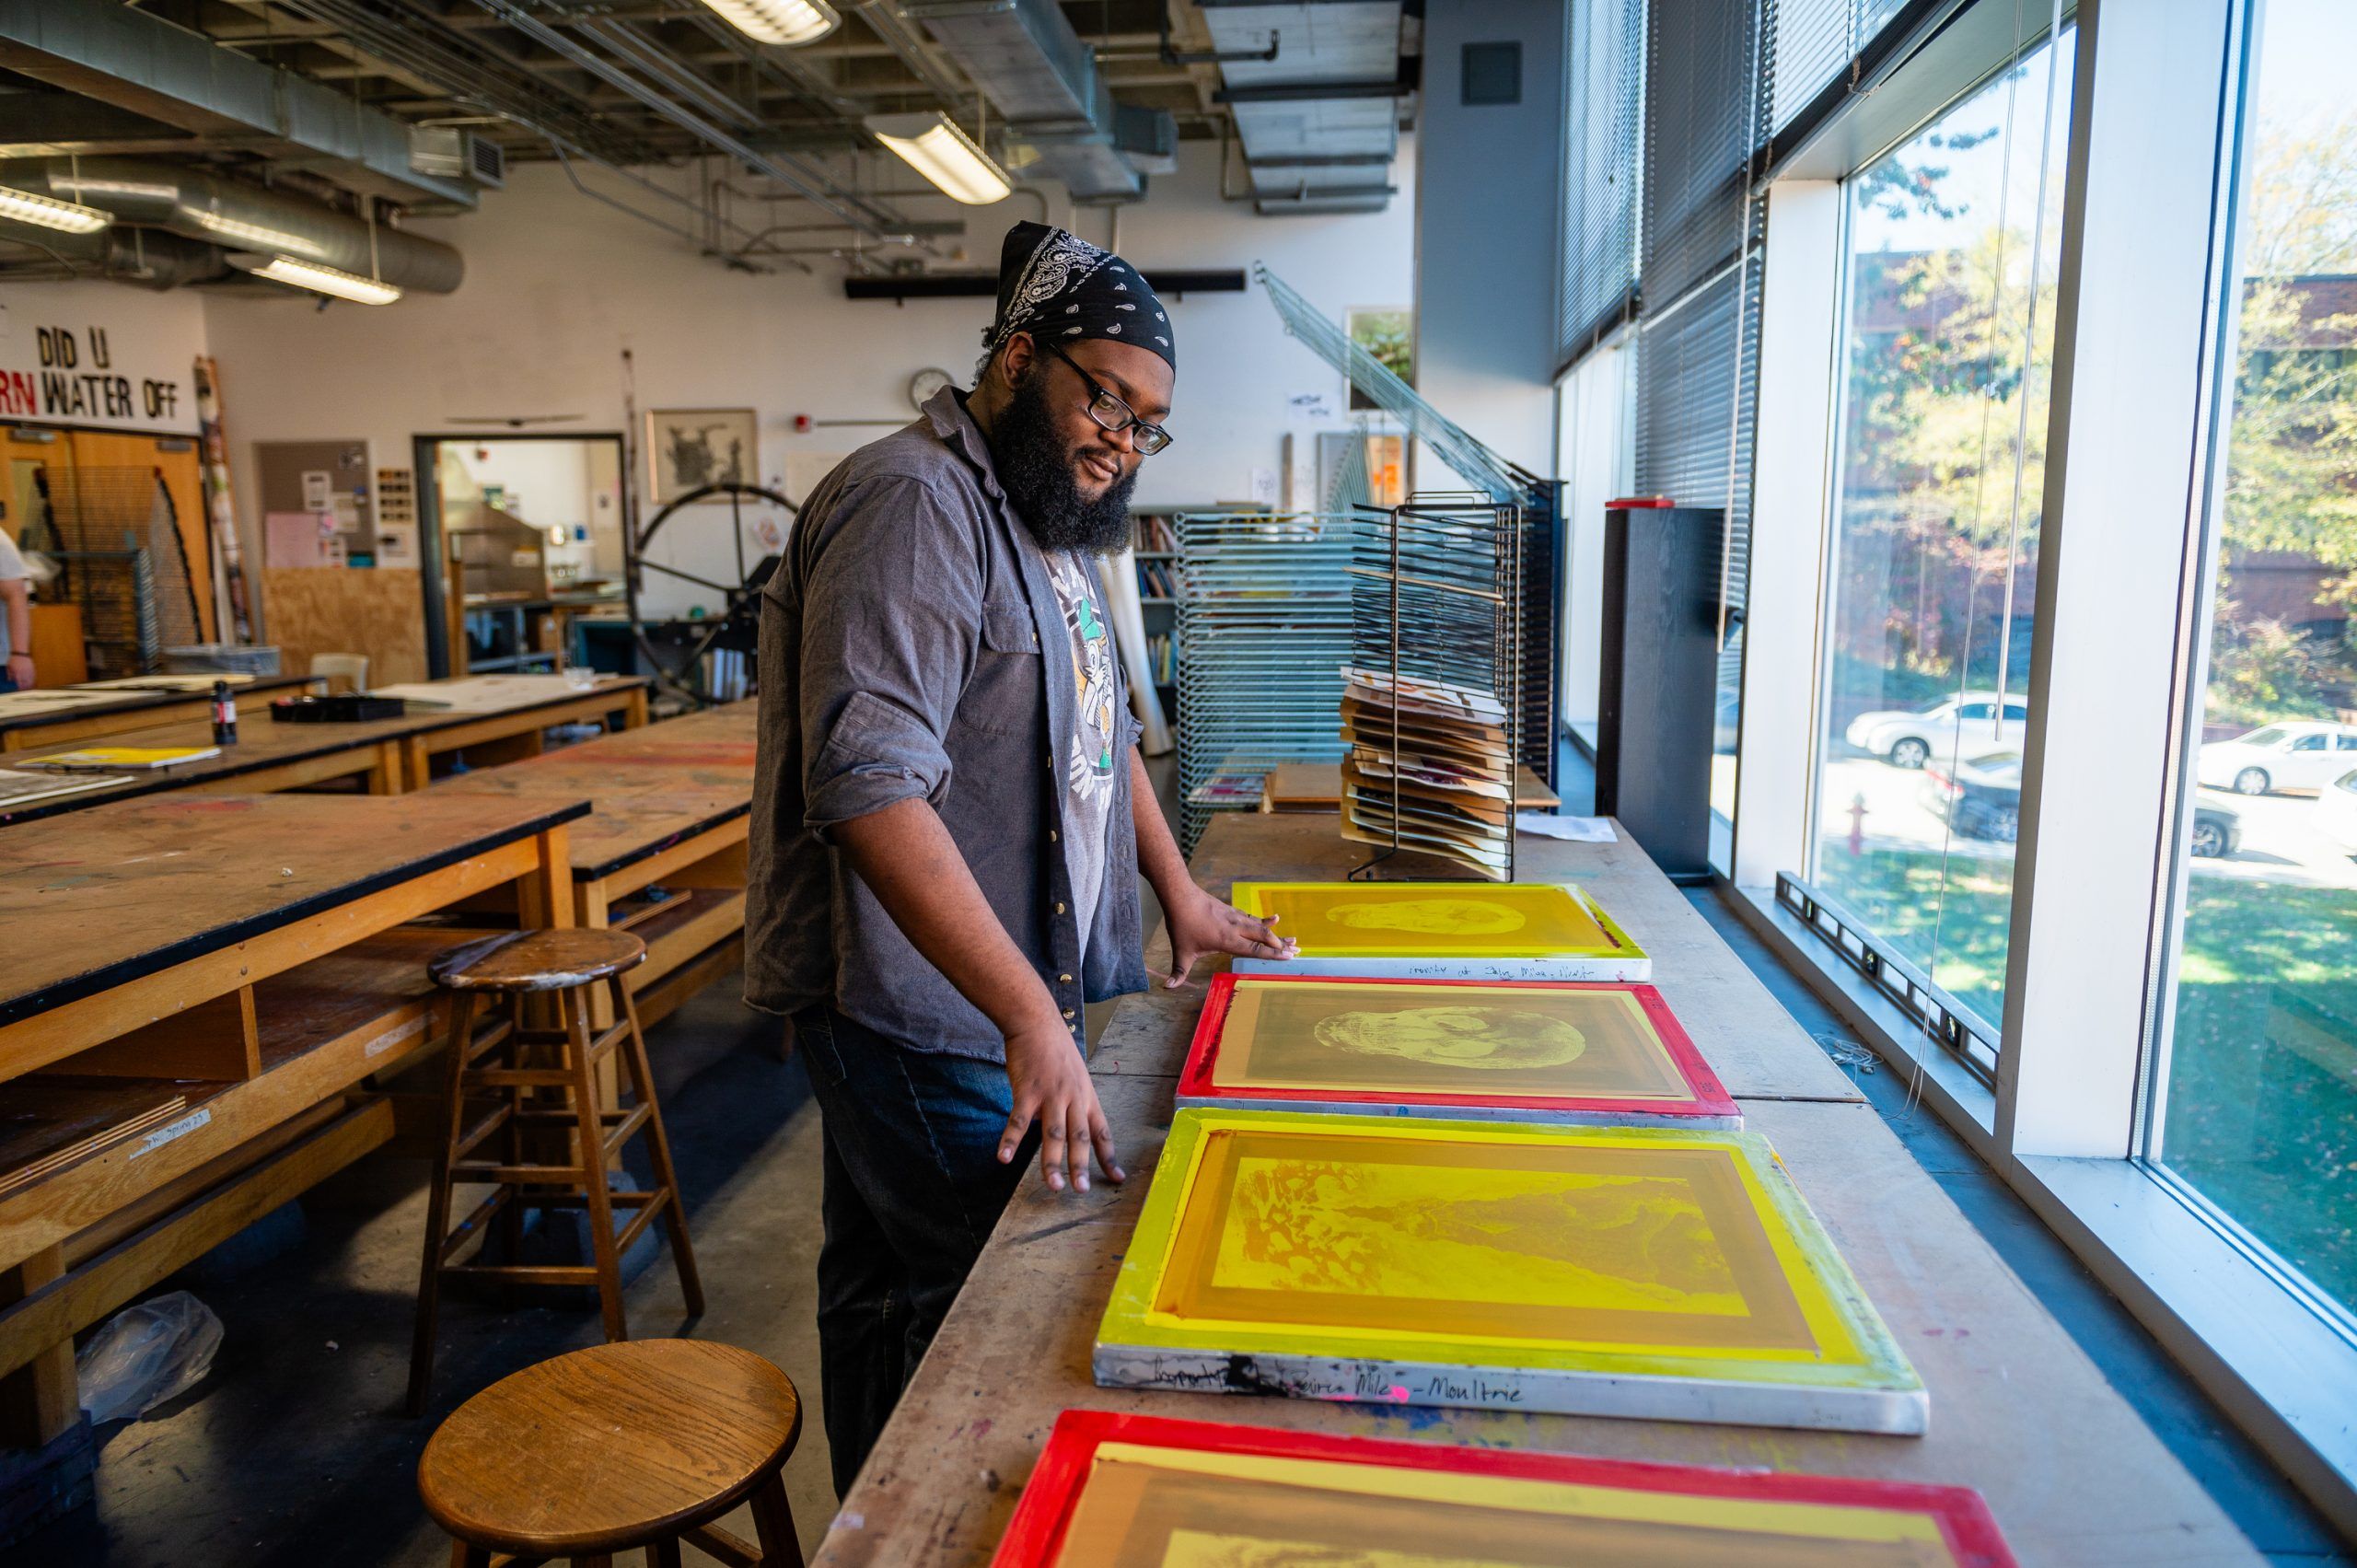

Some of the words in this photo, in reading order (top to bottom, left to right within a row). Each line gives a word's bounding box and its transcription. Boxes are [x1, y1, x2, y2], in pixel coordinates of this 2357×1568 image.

[37, 326, 76, 367] DID
[89, 326, 109, 367] U
[41, 372, 133, 416] WATER
[143, 377, 178, 418] OFF
